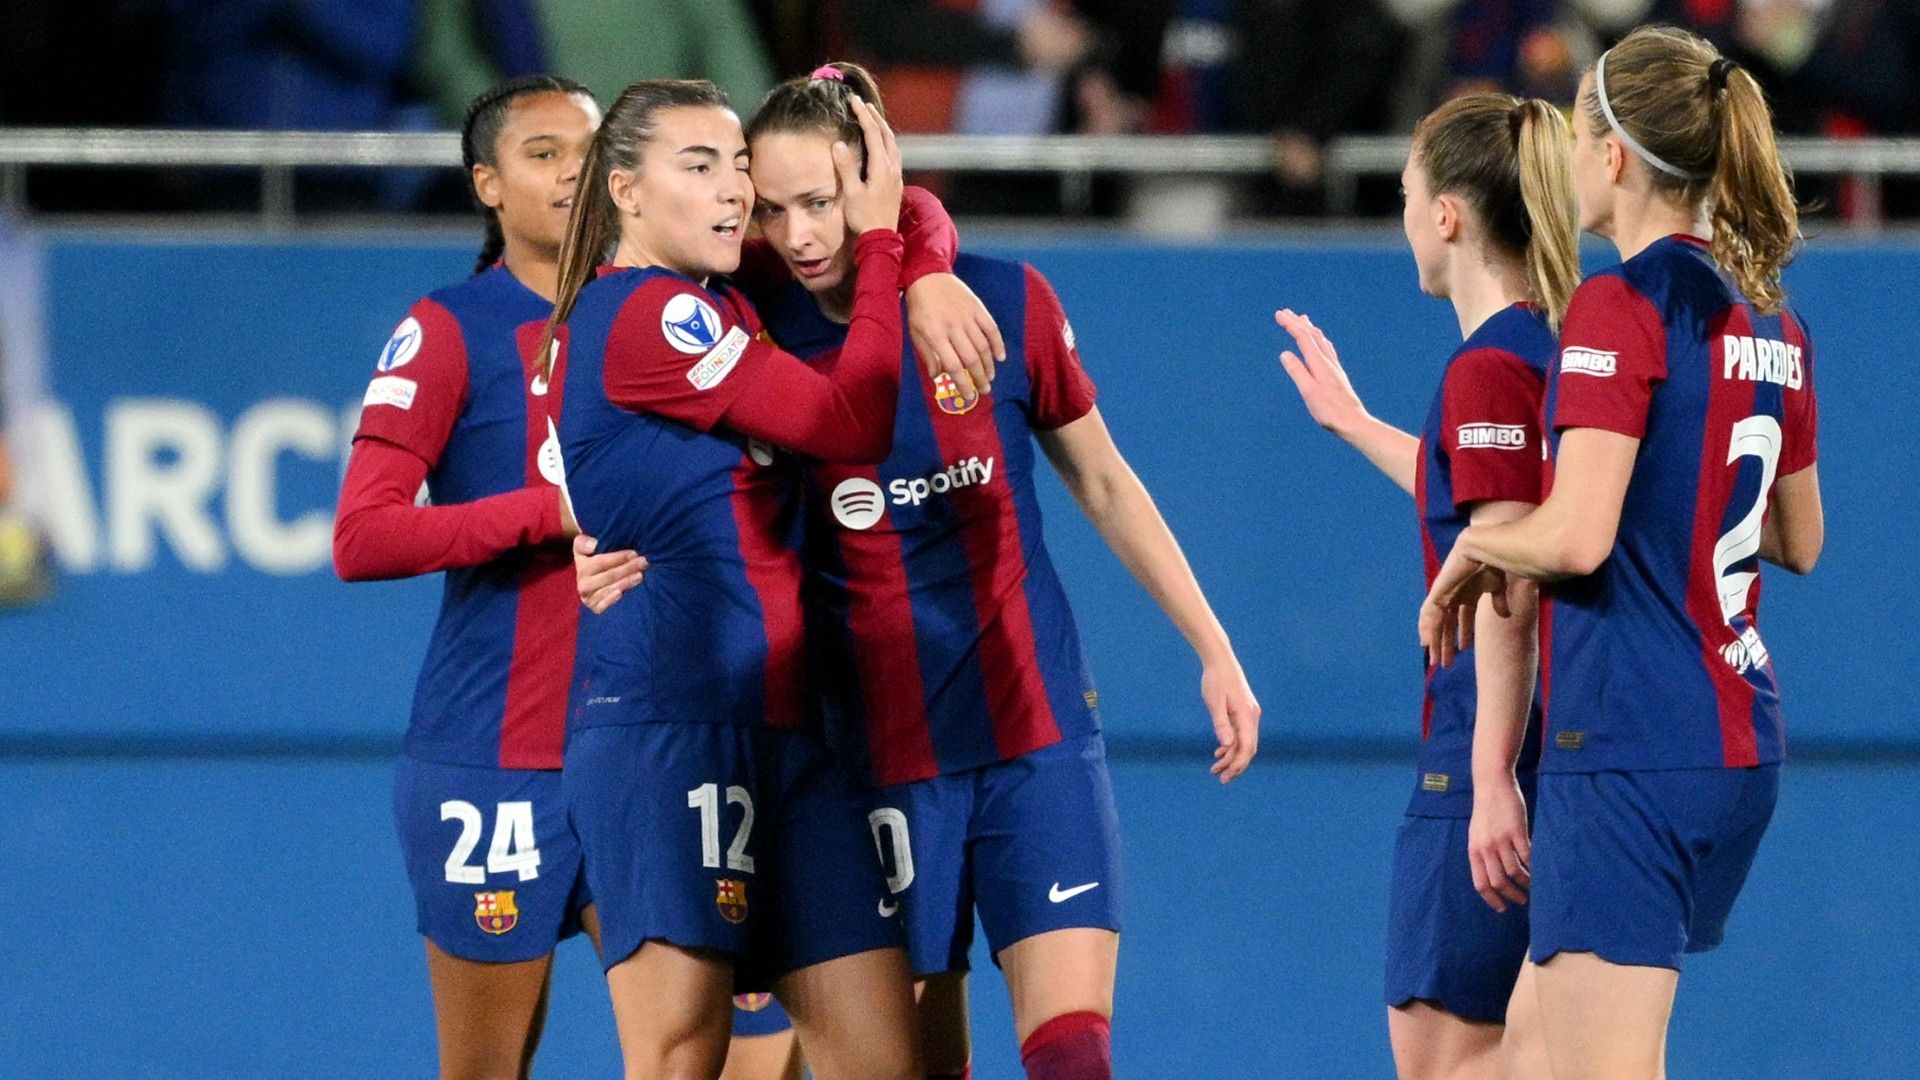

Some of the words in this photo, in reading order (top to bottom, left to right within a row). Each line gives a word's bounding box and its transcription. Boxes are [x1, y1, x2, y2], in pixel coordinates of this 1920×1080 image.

[1560, 350, 1617, 373] BIMBO
[1723, 334, 1803, 391] PAREDES
[1457, 426, 1526, 446] BIMBO
[10, 396, 361, 576] ARC
[888, 455, 994, 506] Spotify
[1712, 414, 1783, 627] 2
[440, 800, 541, 884] 24
[688, 783, 756, 874] 12
